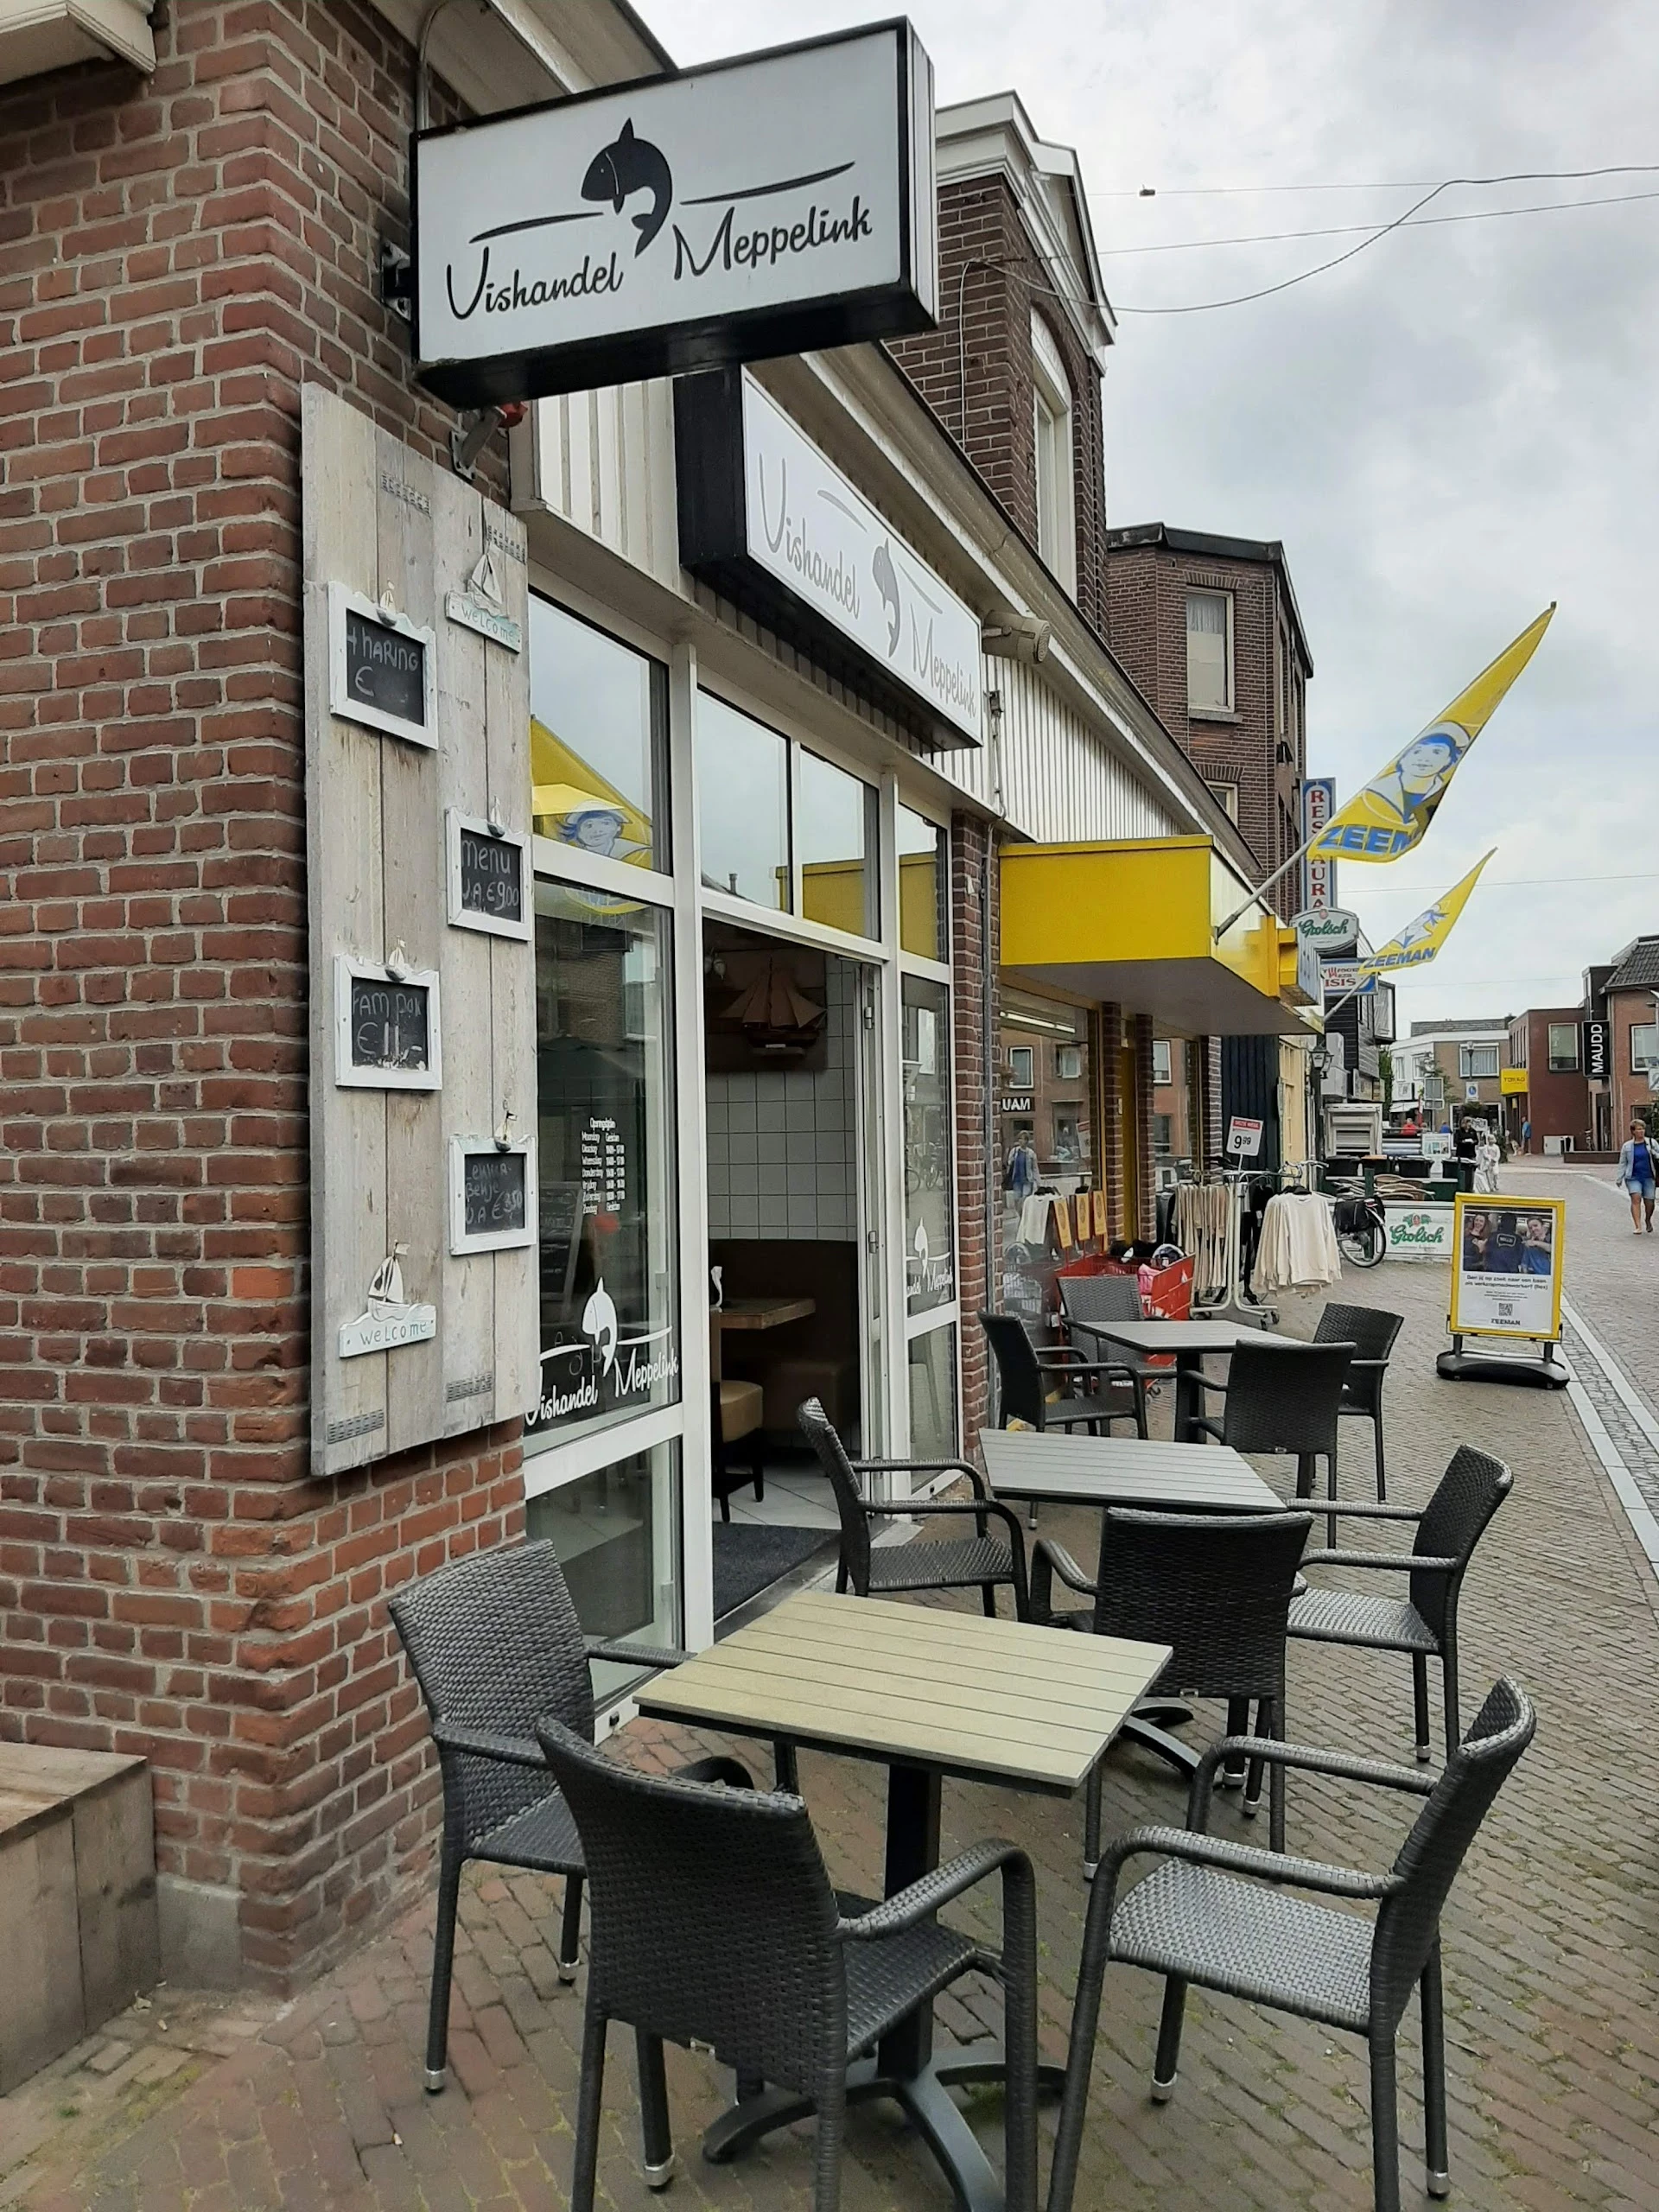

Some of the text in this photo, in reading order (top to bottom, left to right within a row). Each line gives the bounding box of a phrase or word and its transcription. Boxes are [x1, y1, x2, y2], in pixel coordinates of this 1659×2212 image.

[447, 195, 873, 320] Vishandel Meppelink
[759, 453, 976, 718] Vishandel Meppelink
[1299, 918, 1350, 938] Grolsch
[1363, 947, 1436, 969] ZEEMAN
[1325, 978, 1357, 987] ISIS
[1591, 1024, 1604, 1073] MAUDD
[1389, 1224, 1445, 1245] Grolsch
[614, 1347, 679, 1398] Meppelink
